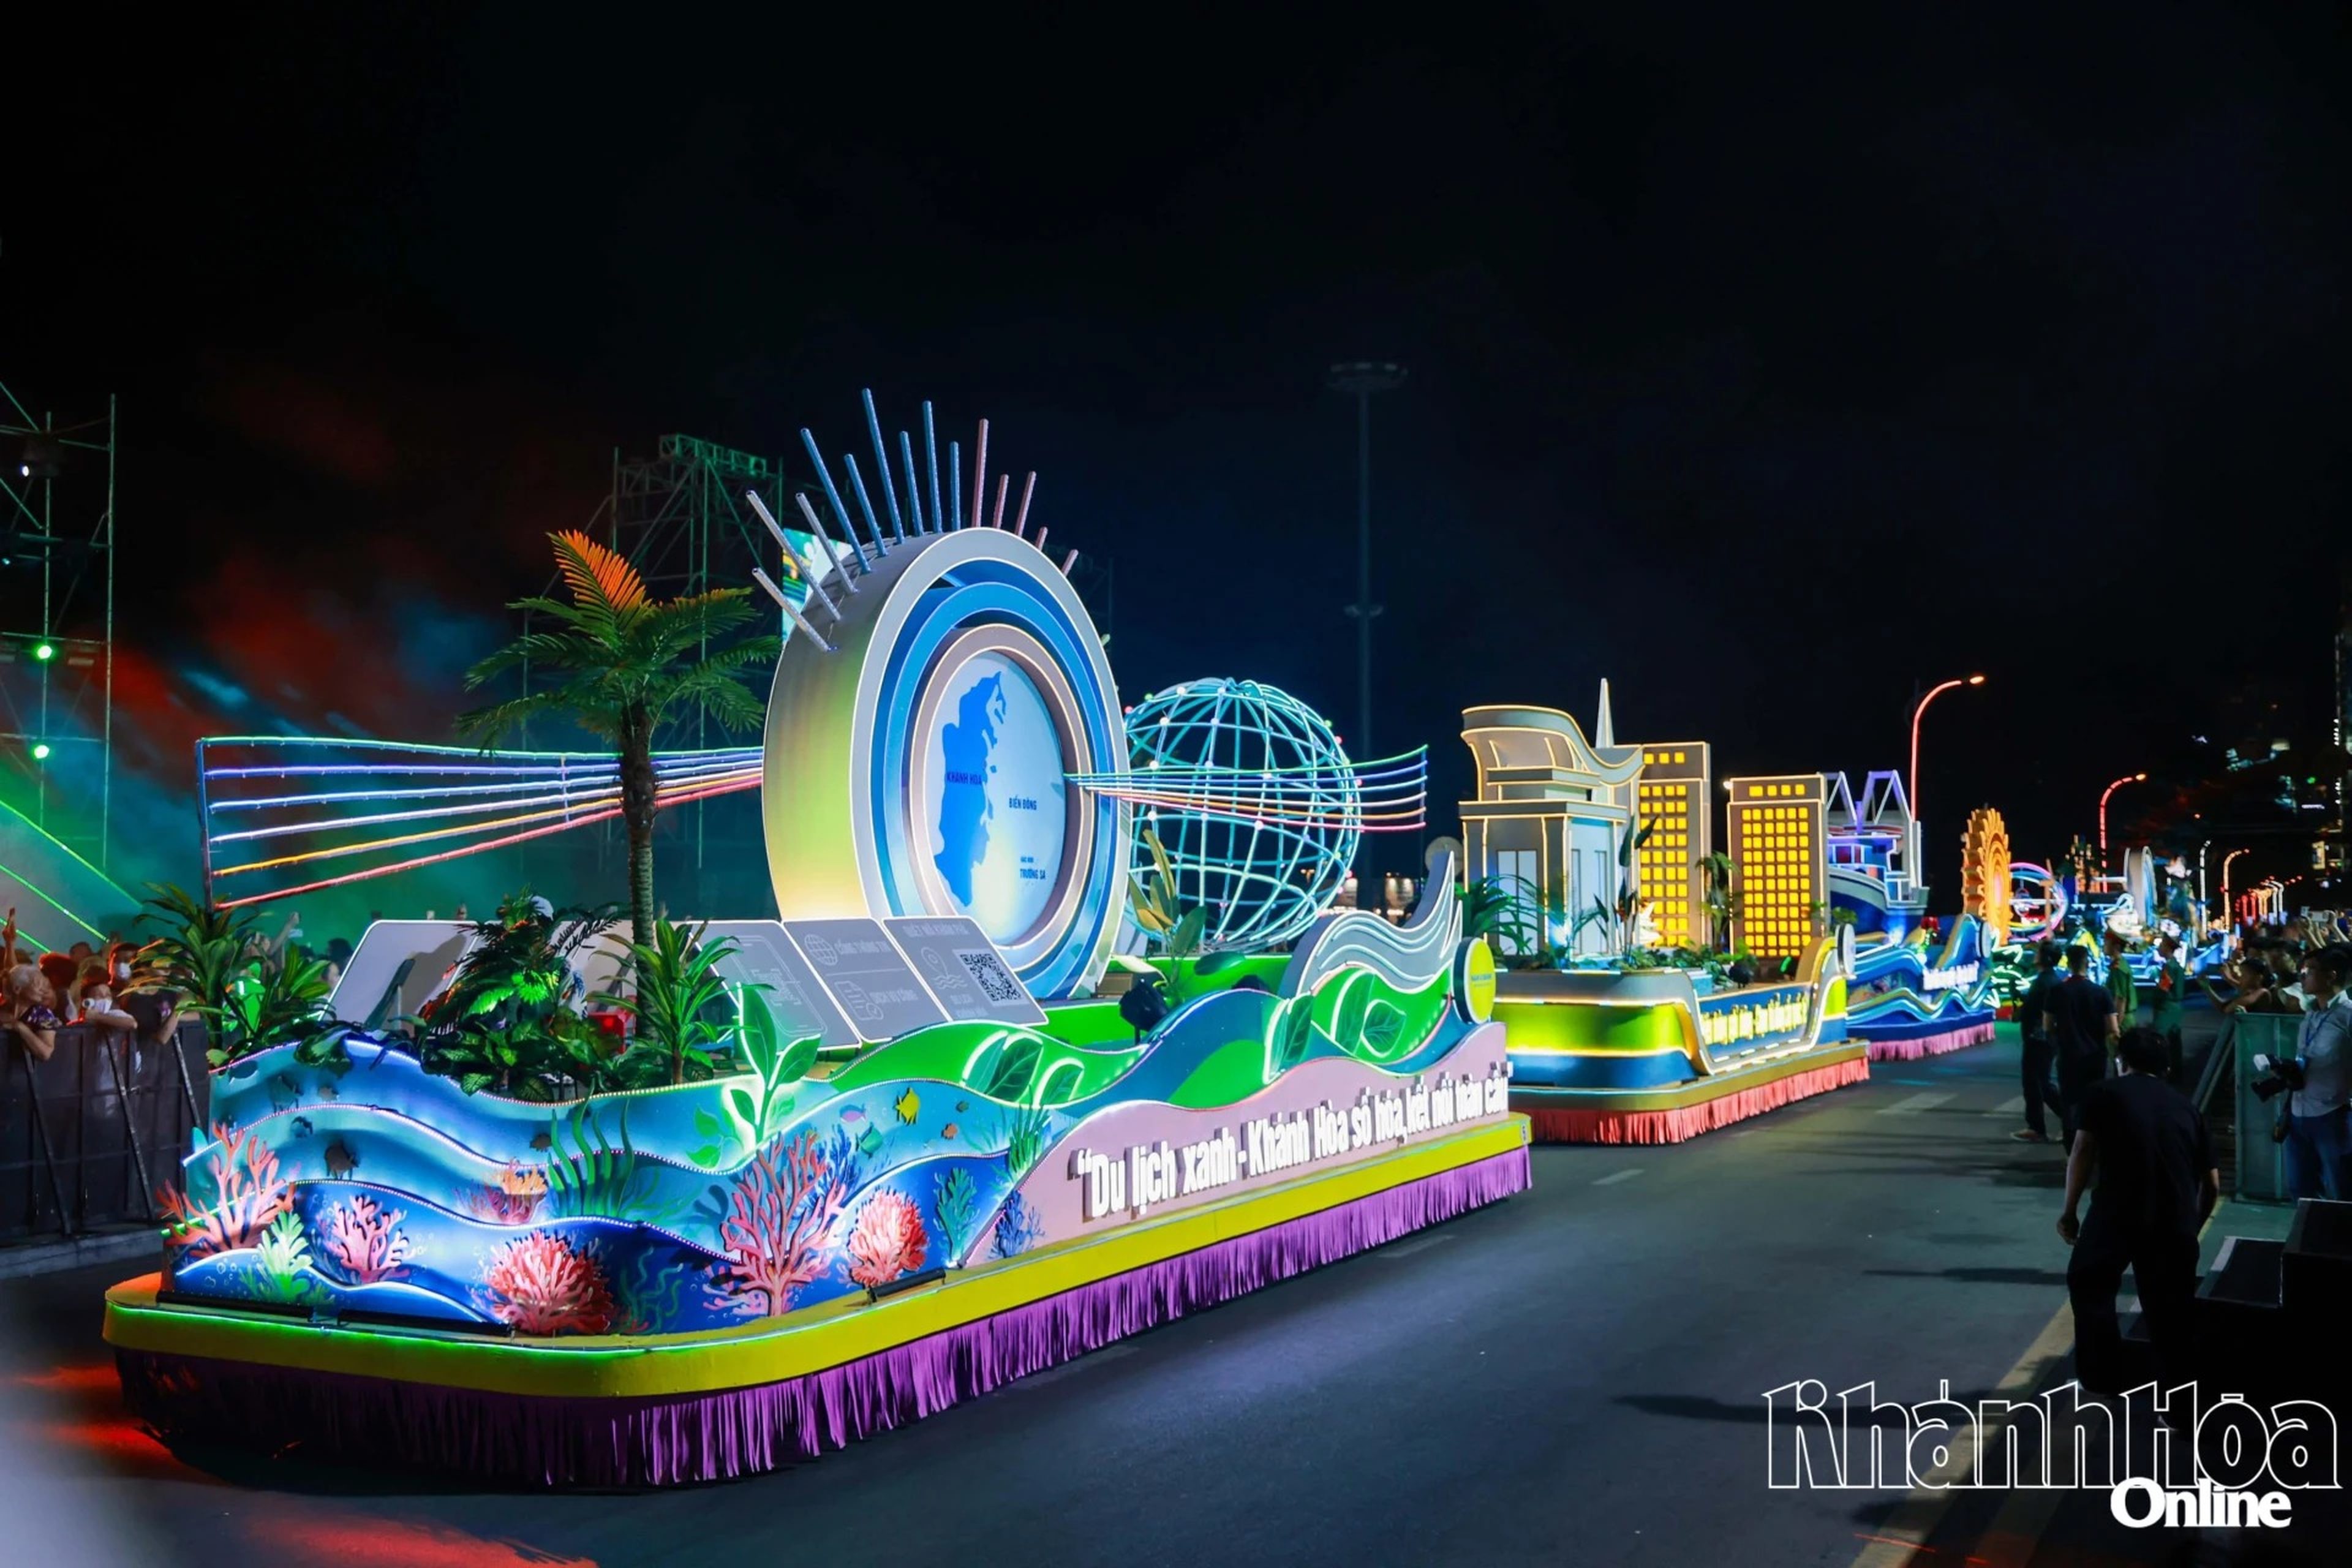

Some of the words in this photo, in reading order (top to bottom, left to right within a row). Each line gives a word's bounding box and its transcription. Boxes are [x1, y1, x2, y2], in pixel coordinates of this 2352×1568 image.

[1132, 1140, 1177, 1216] lịch
[1183, 1126, 1237, 1194] xanh
[1248, 1111, 1310, 1176] Khánh
[1313, 1098, 1349, 1159] Hòa
[1351, 1086, 1373, 1148] số
[1406, 1074, 1431, 1134] kết
[1431, 1071, 1455, 1128] nối
[1455, 1072, 1483, 1122] toàn
